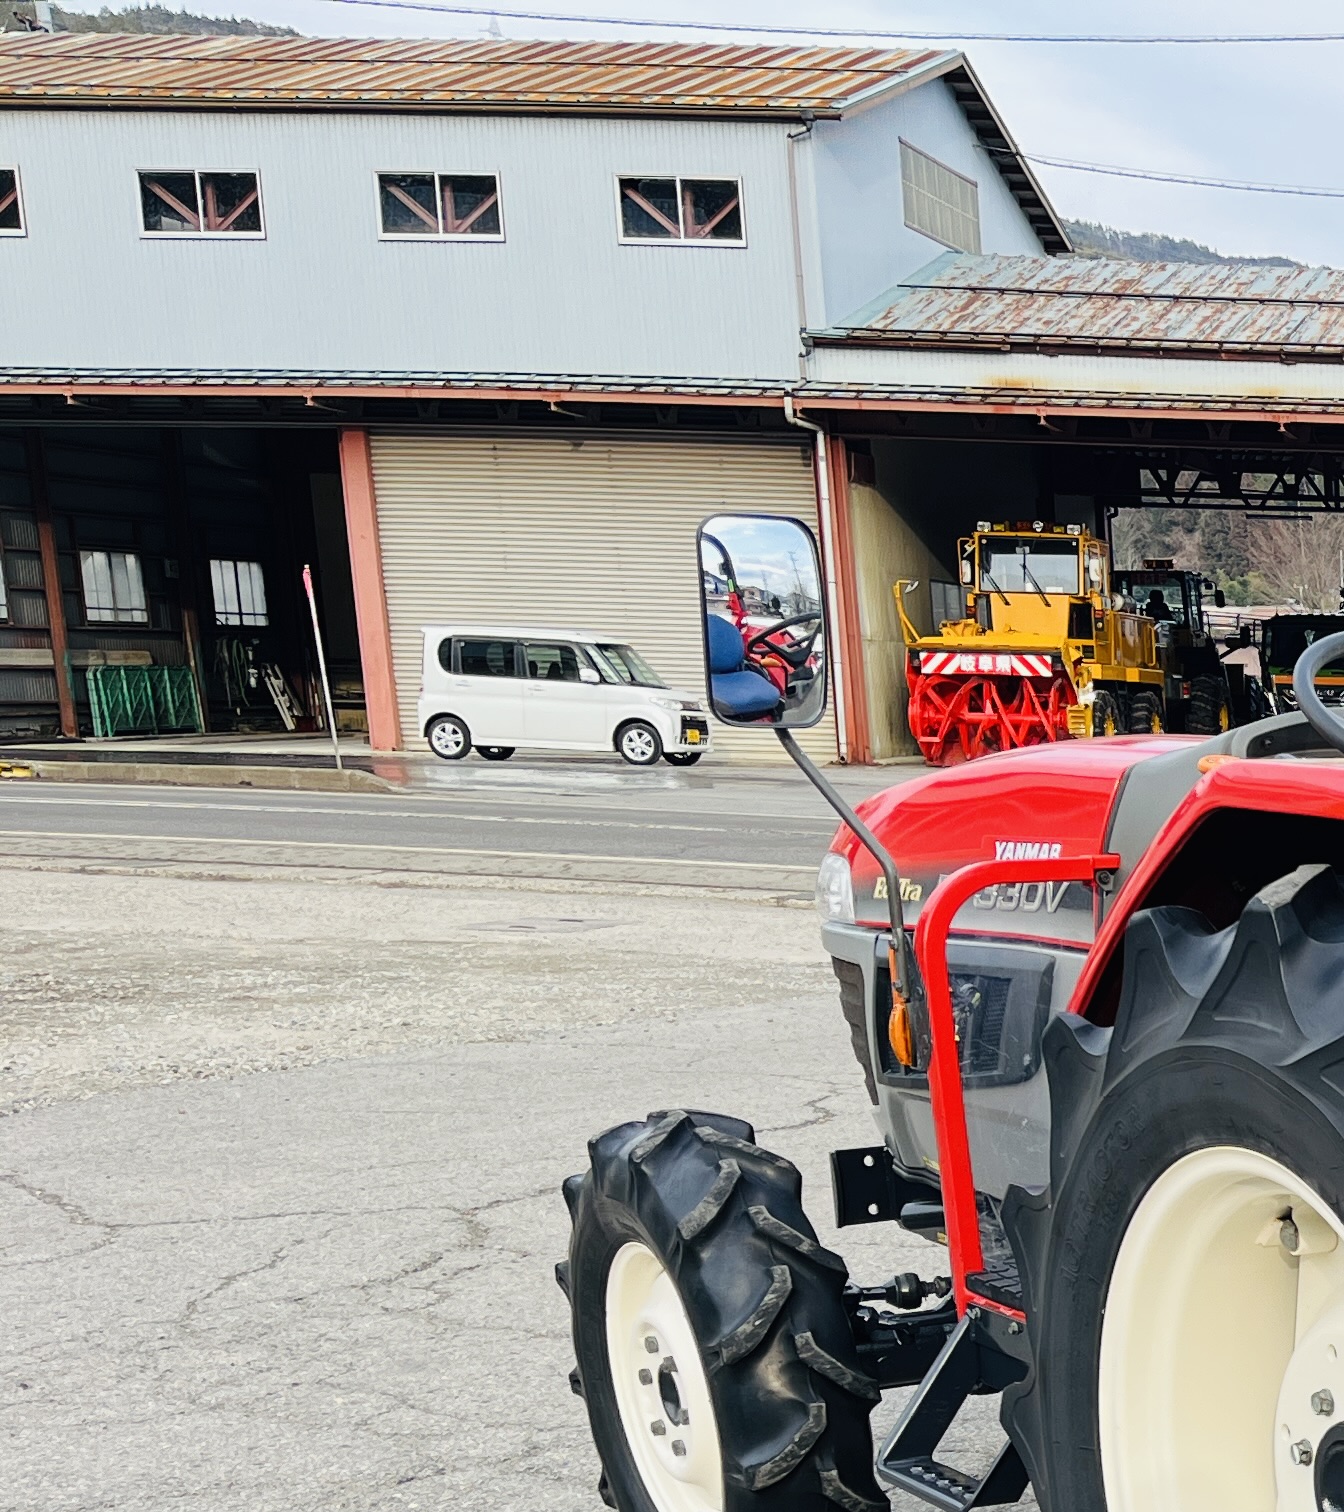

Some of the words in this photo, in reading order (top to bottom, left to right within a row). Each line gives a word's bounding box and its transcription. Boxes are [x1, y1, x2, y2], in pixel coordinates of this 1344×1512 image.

[960, 654, 1012, 673] 岐阜県
[995, 841, 1061, 860] YANMAR
[873, 876, 923, 901] EcTra
